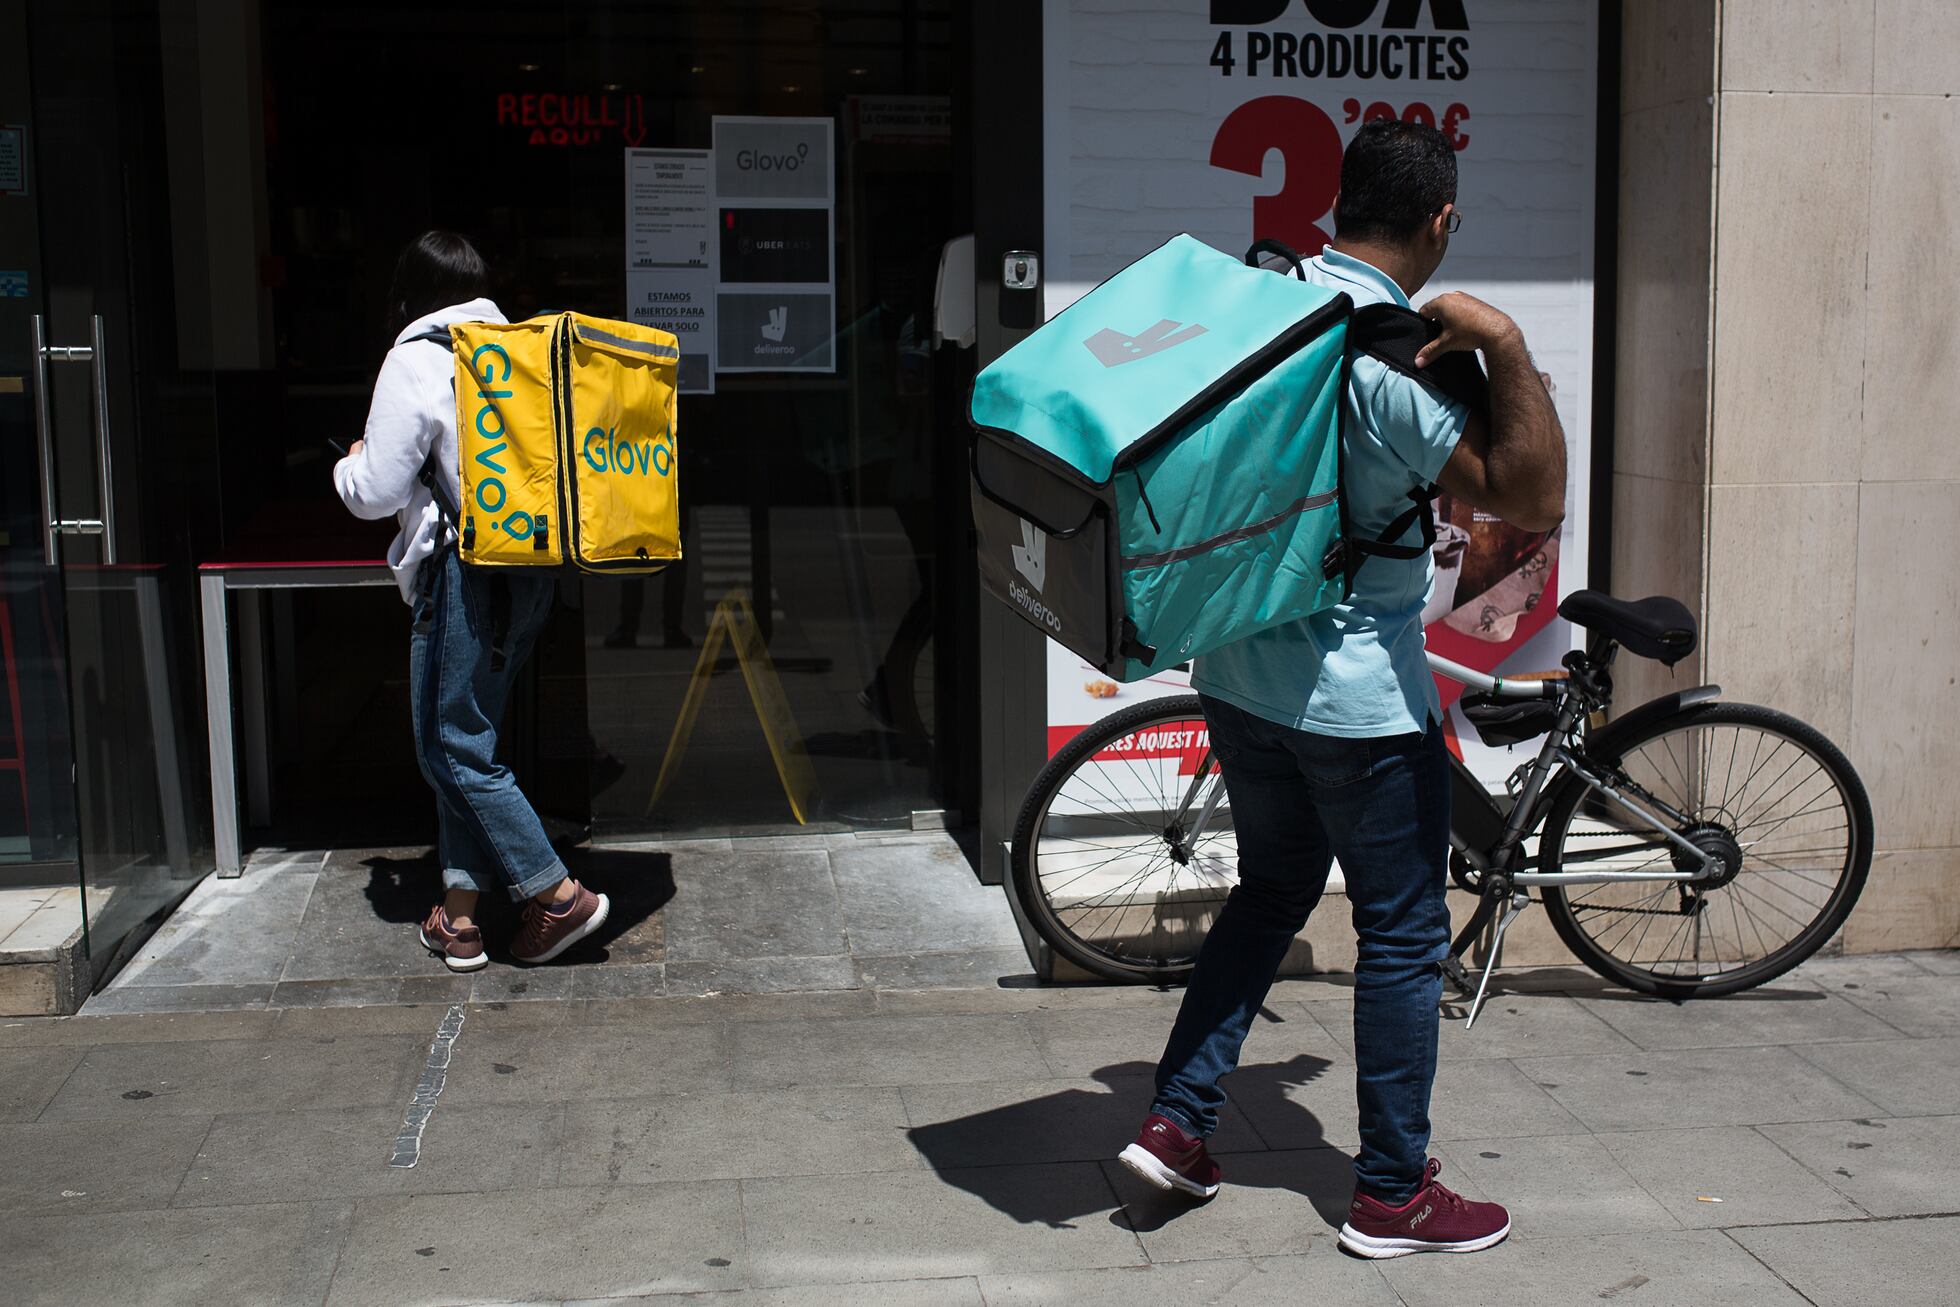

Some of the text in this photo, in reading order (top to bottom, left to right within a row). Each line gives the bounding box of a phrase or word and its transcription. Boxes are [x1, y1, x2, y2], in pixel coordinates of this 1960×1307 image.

[1210, 31, 1470, 81] 4 PRODUCTES
[497, 92, 618, 127] RECULL
[737, 149, 799, 171] Glovo
[756, 240, 784, 249] UBER
[648, 292, 691, 301] ESTAMOS
[635, 307, 705, 315] ABIERTOS PARA
[675, 322, 699, 330] SOLO
[754, 343, 796, 354] deliveroo
[471, 343, 514, 513] Glovo
[584, 426, 670, 477] Glovo
[1009, 580, 1061, 632] deliveroo
[1136, 730, 1195, 753] AQUEST
[1409, 1204, 1433, 1230] FILA
